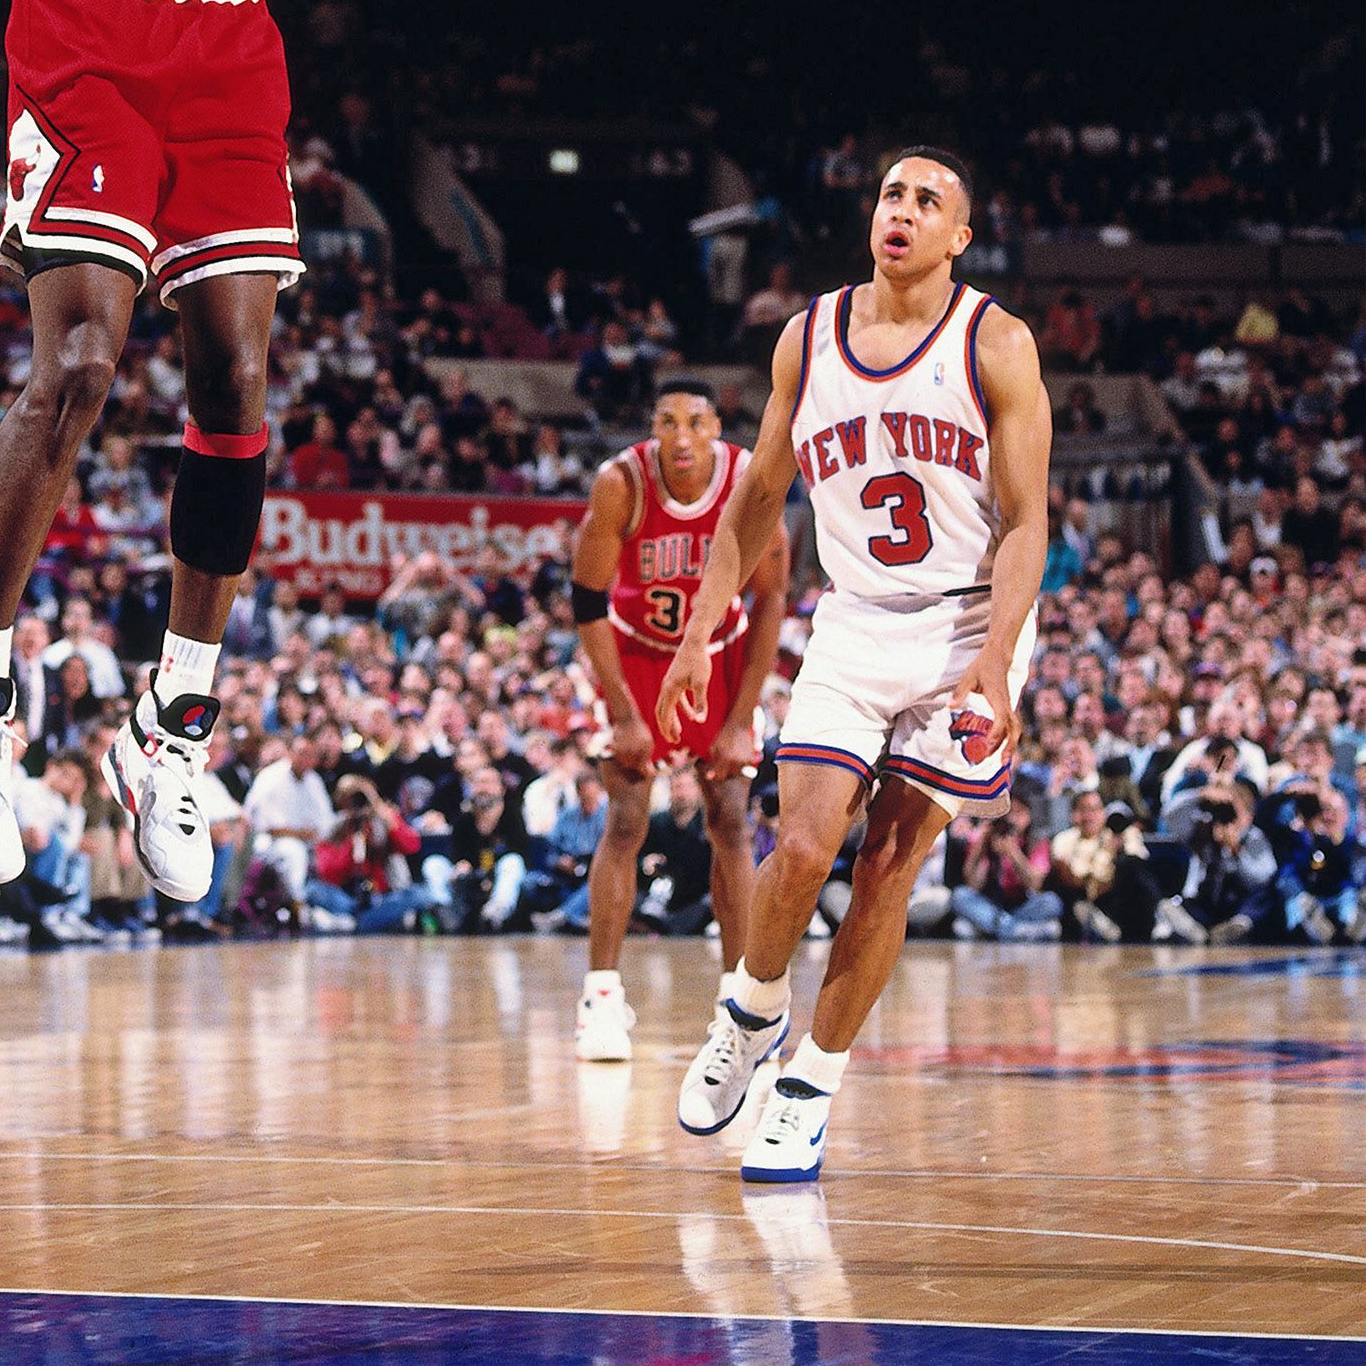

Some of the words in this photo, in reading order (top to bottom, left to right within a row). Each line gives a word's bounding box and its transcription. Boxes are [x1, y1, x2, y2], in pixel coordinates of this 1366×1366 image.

[796, 415, 867, 492] NEW
[880, 411, 984, 482] YORK
[260, 498, 572, 572] Budweise
[860, 471, 934, 567] 3
[644, 584, 700, 638] 3
